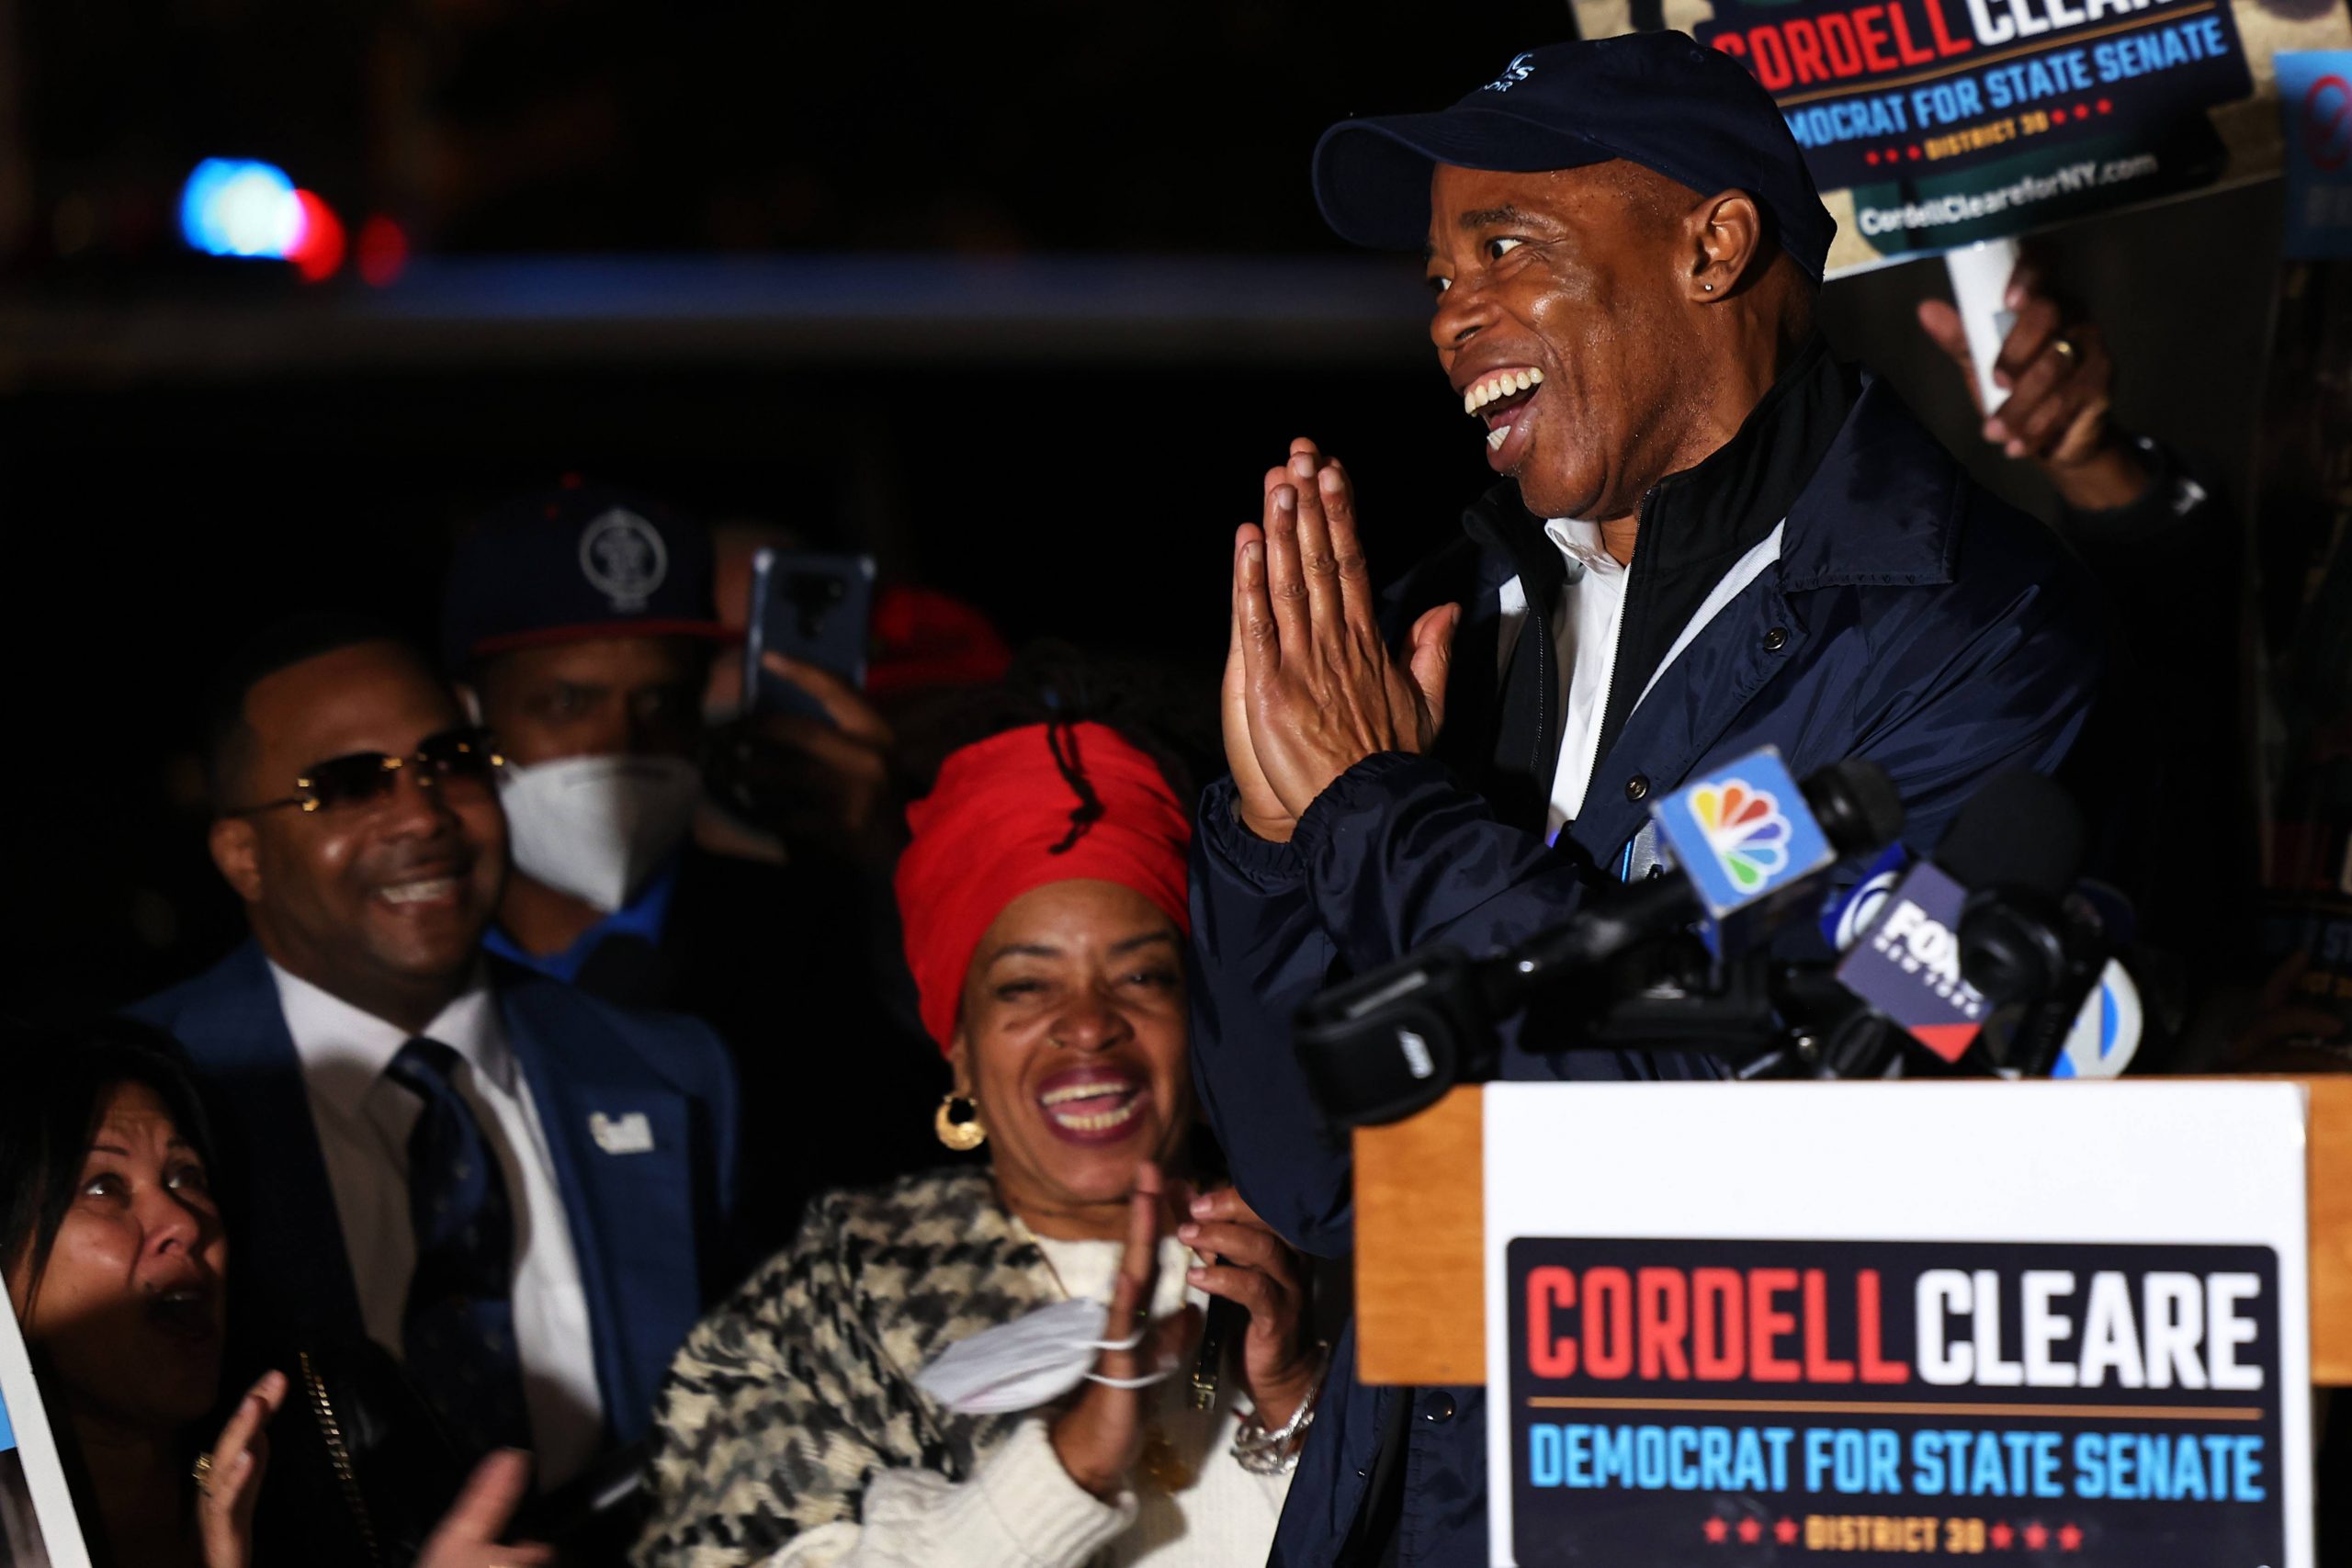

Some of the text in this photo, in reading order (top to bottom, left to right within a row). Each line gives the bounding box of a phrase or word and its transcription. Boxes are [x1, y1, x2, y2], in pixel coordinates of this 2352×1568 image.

[1784, 15, 2230, 150] MOCRAT FOR STATE SENATE
[1922, 117, 2018, 162] DISTRICT
[1859, 152, 2159, 236] CordellCleareforNY.com
[1526, 1265, 2265, 1391] CORDELL CLEARE
[1529, 1423, 2267, 1503] DEMOCRAT FOR STATE SENATE
[1804, 1513, 1986, 1554] DISTRICT 30
